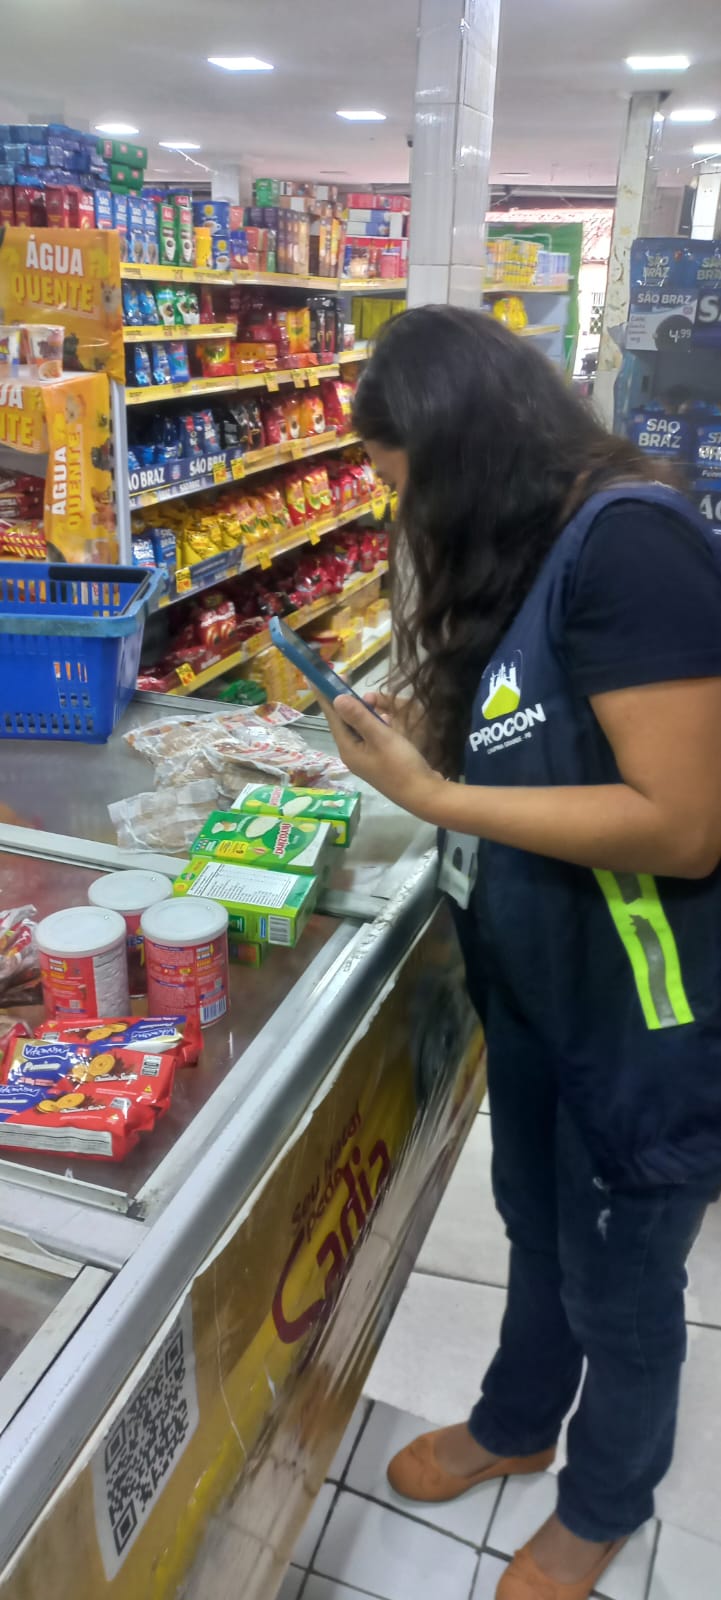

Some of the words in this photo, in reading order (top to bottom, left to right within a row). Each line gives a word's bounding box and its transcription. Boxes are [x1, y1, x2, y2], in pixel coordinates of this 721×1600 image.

[26, 234, 84, 277] ÁGUA
[13, 273, 94, 312] QUENTE
[661, 294, 692, 305] BRAZ
[638, 432, 682, 448] BRAZ
[45, 446, 67, 516] ÁGUA
[140, 466, 166, 489] BRAZ
[469, 703, 546, 752] PROCON
